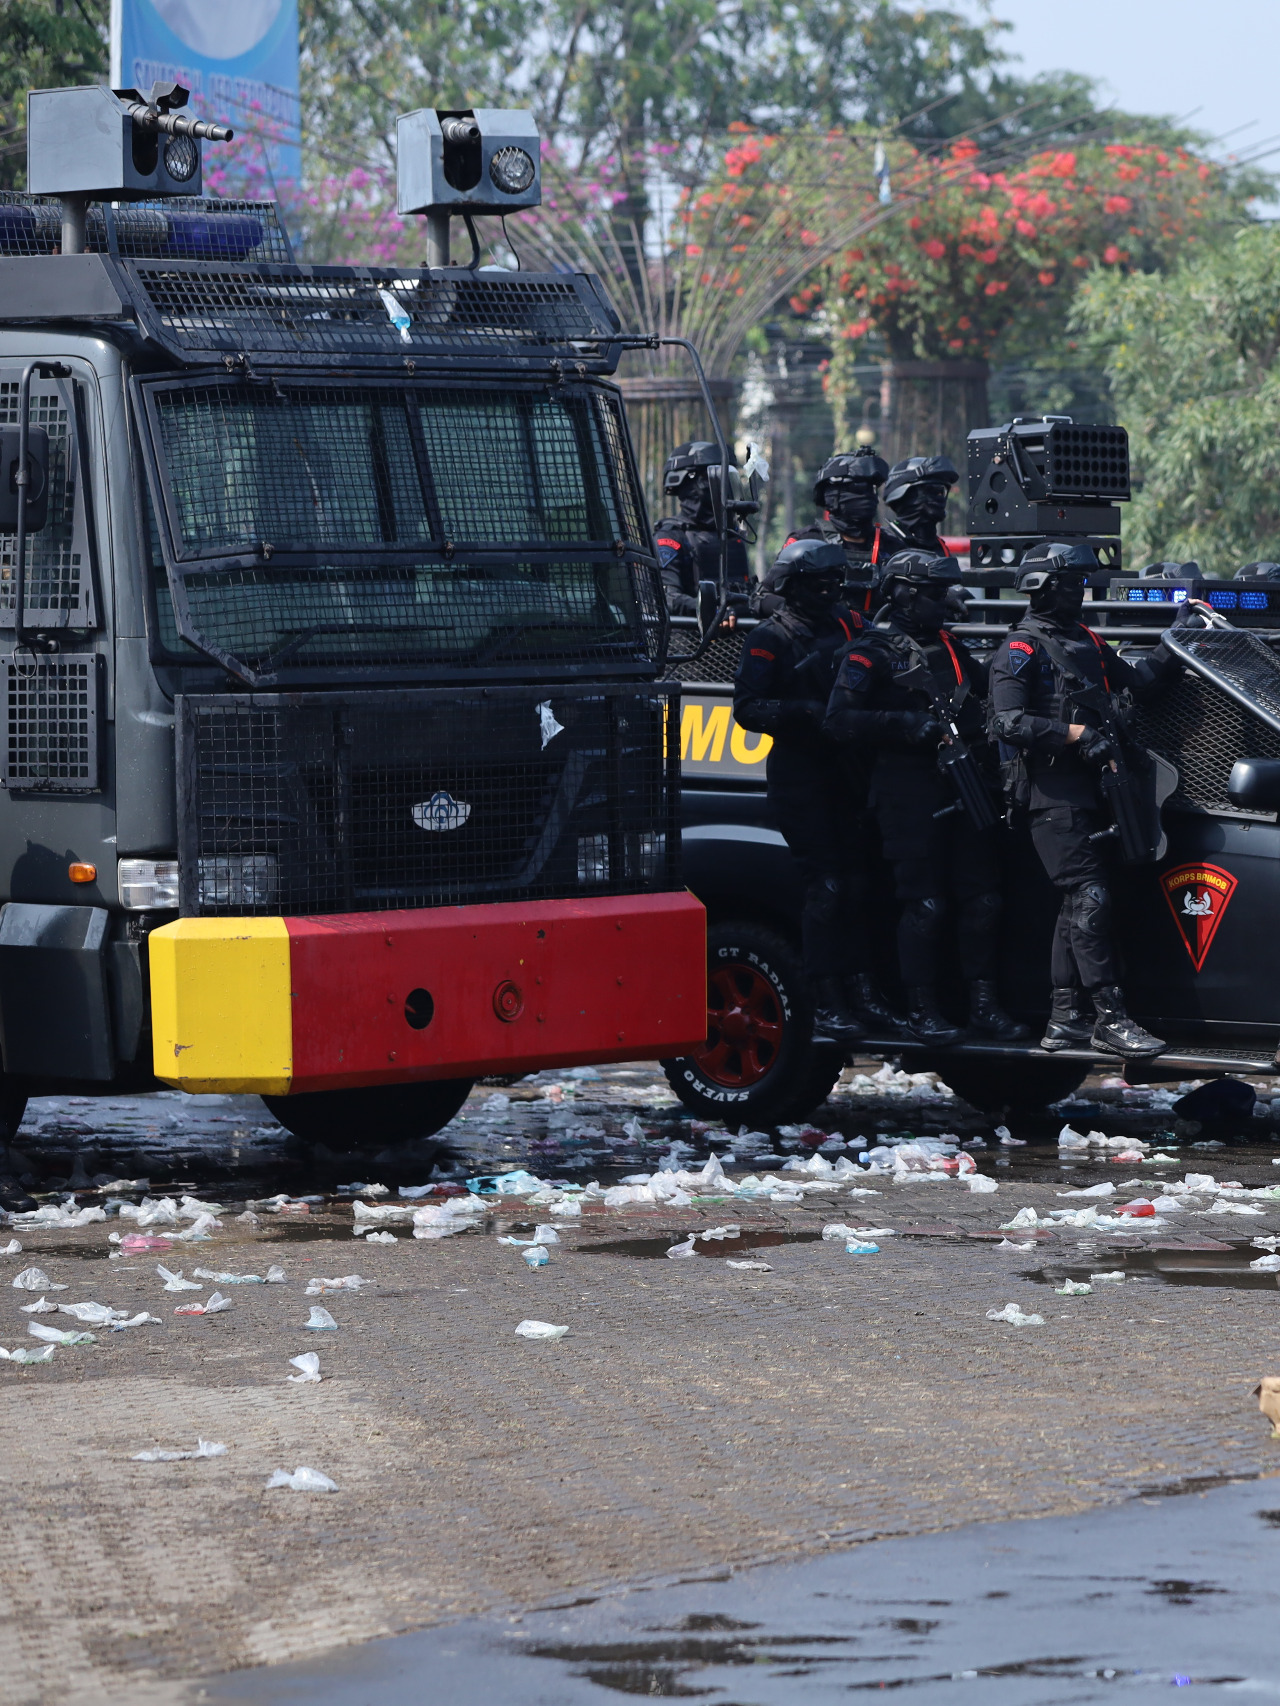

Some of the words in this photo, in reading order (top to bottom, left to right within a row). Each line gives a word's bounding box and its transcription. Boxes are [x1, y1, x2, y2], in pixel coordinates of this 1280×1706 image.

[1168, 873, 1195, 888] KORPS
[1196, 873, 1228, 890] BRIMOB
[718, 948, 740, 957] GT
[748, 953, 792, 1021] RADIAL
[683, 1070, 750, 1102] SAVERO
